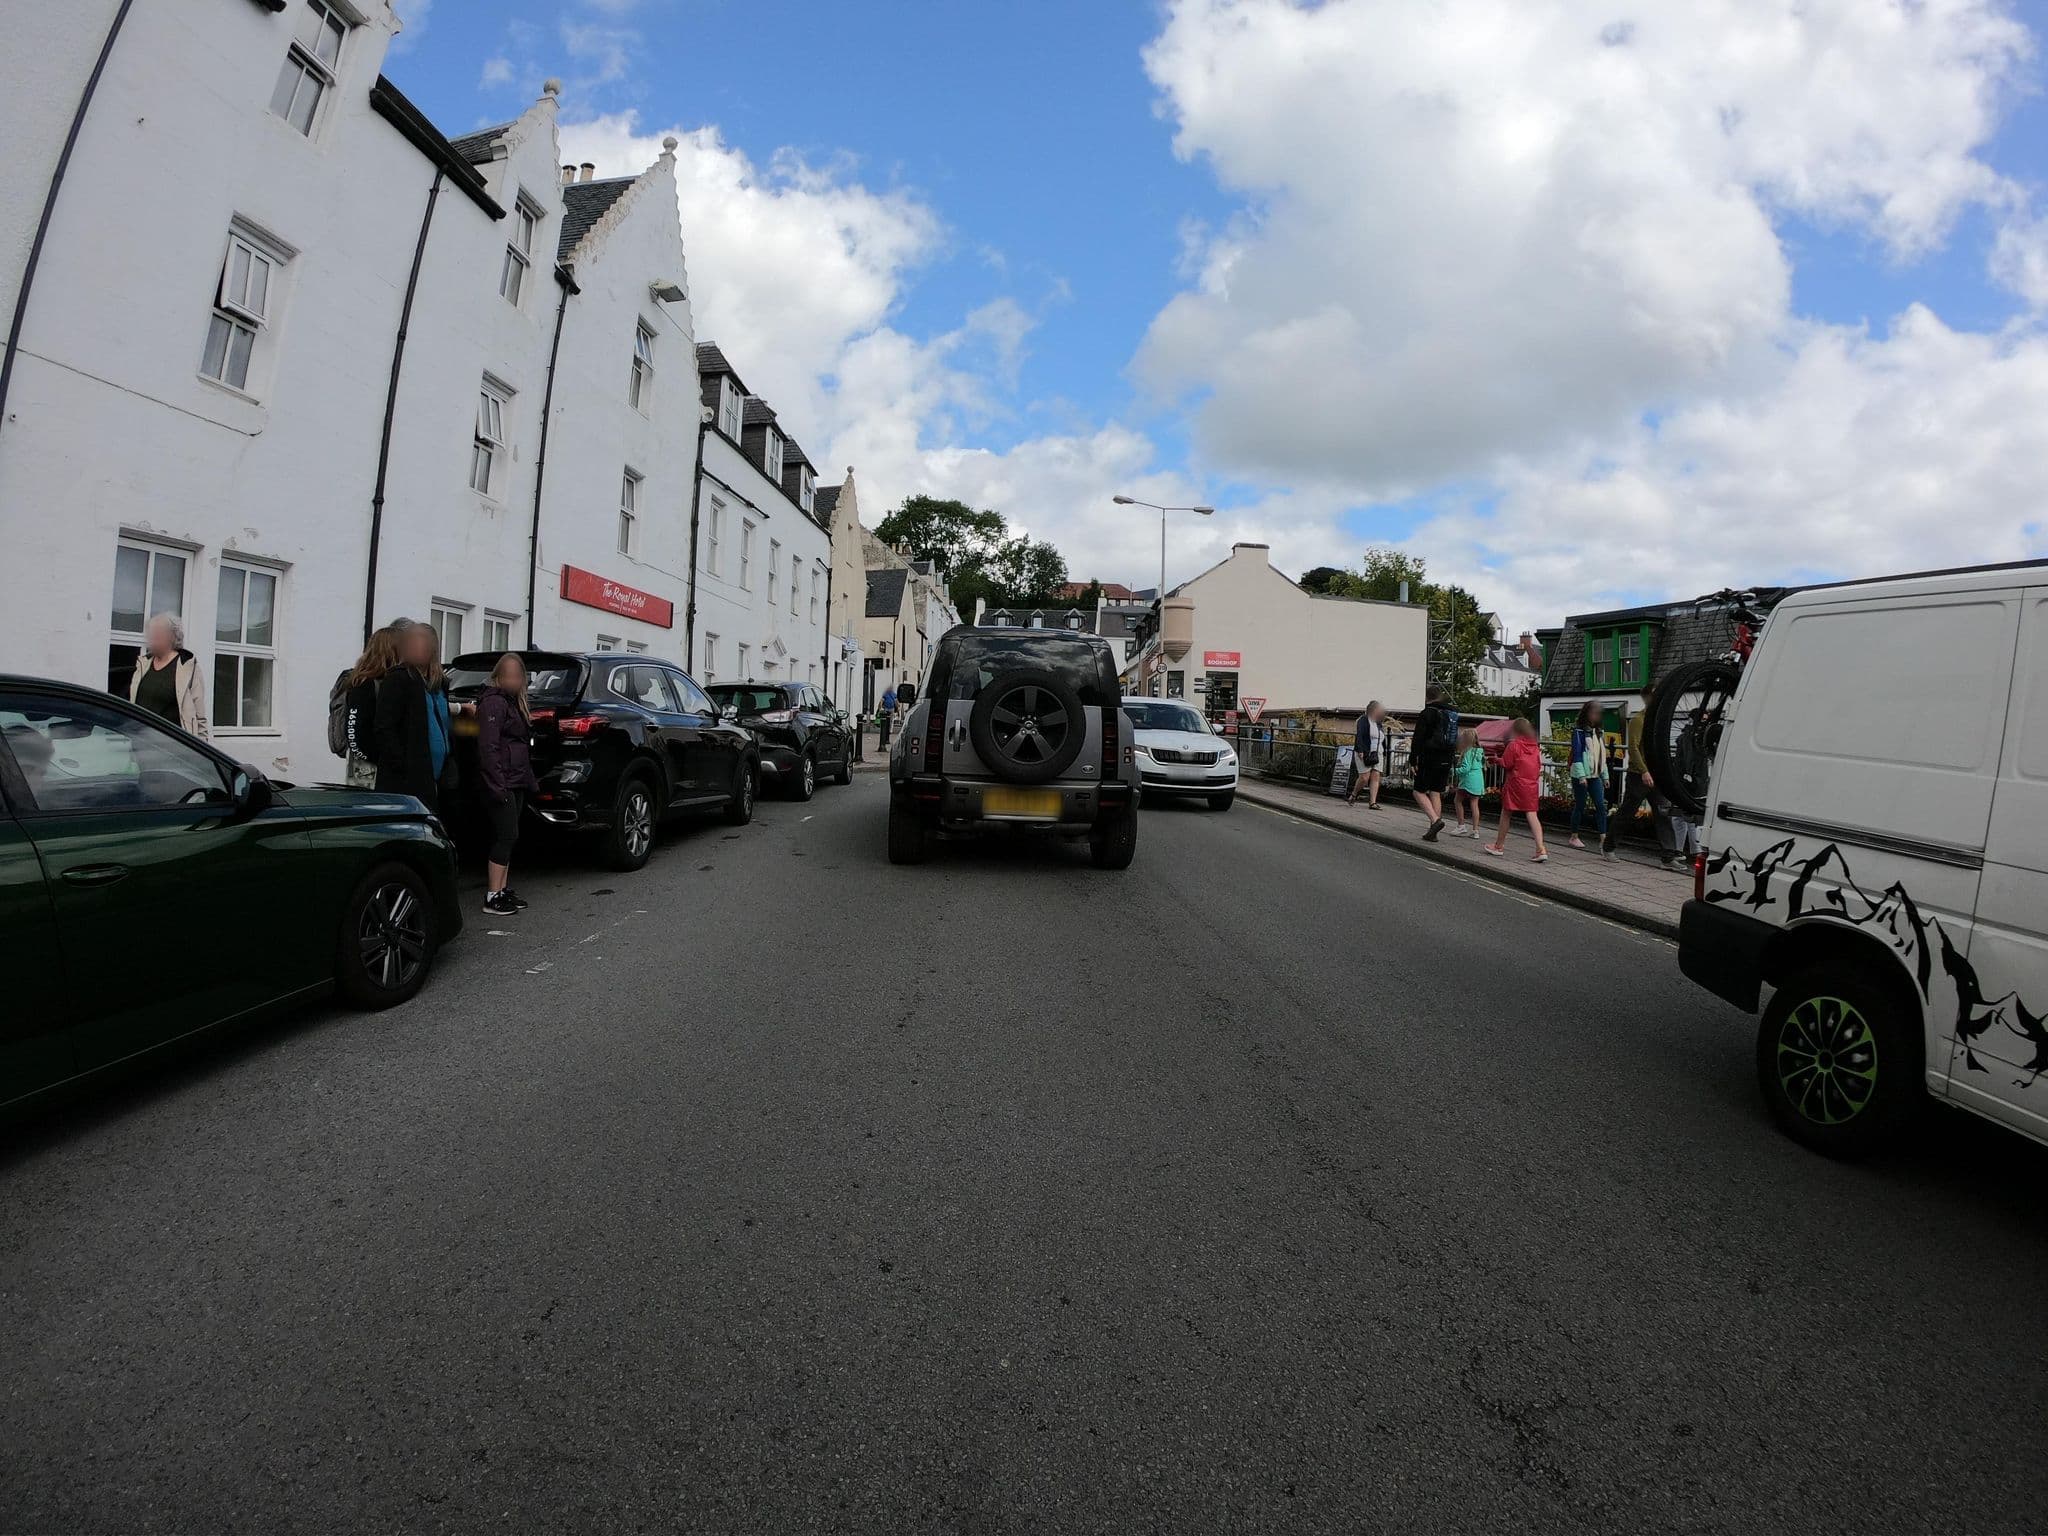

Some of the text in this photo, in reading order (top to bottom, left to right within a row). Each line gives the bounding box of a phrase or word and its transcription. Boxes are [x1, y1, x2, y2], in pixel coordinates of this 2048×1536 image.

[603, 582, 612, 598] The
[613, 587, 631, 605] Royal
[631, 593, 646, 608] Hotel
